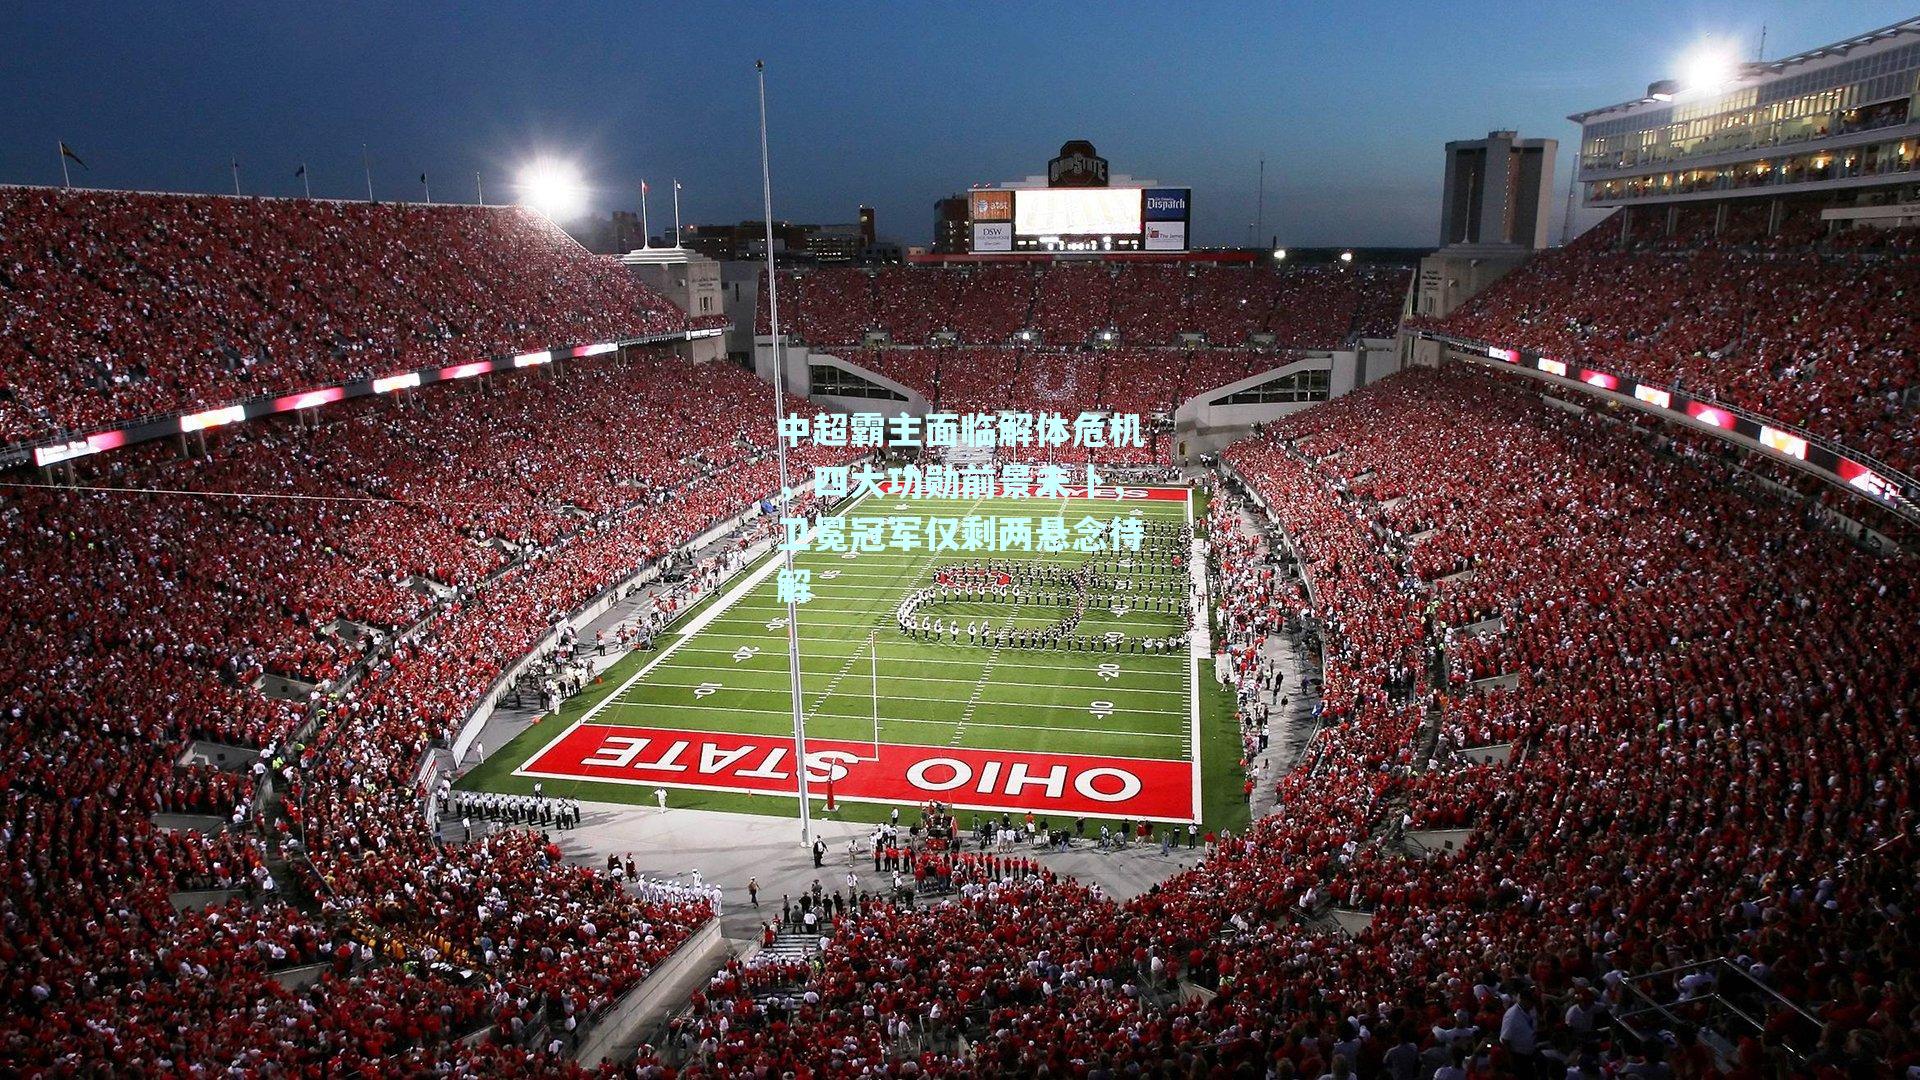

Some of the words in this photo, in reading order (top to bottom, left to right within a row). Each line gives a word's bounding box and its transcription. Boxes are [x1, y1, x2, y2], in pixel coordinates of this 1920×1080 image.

[1147, 198, 1186, 211] Dispatch
[983, 228, 1002, 236] DSW
[733, 646, 760, 660] 20
[1097, 663, 1120, 678] 20
[694, 682, 723, 695] 10
[1089, 701, 1114, 715] 10
[580, 735, 859, 783] STATE
[905, 756, 1143, 802] OHIO
